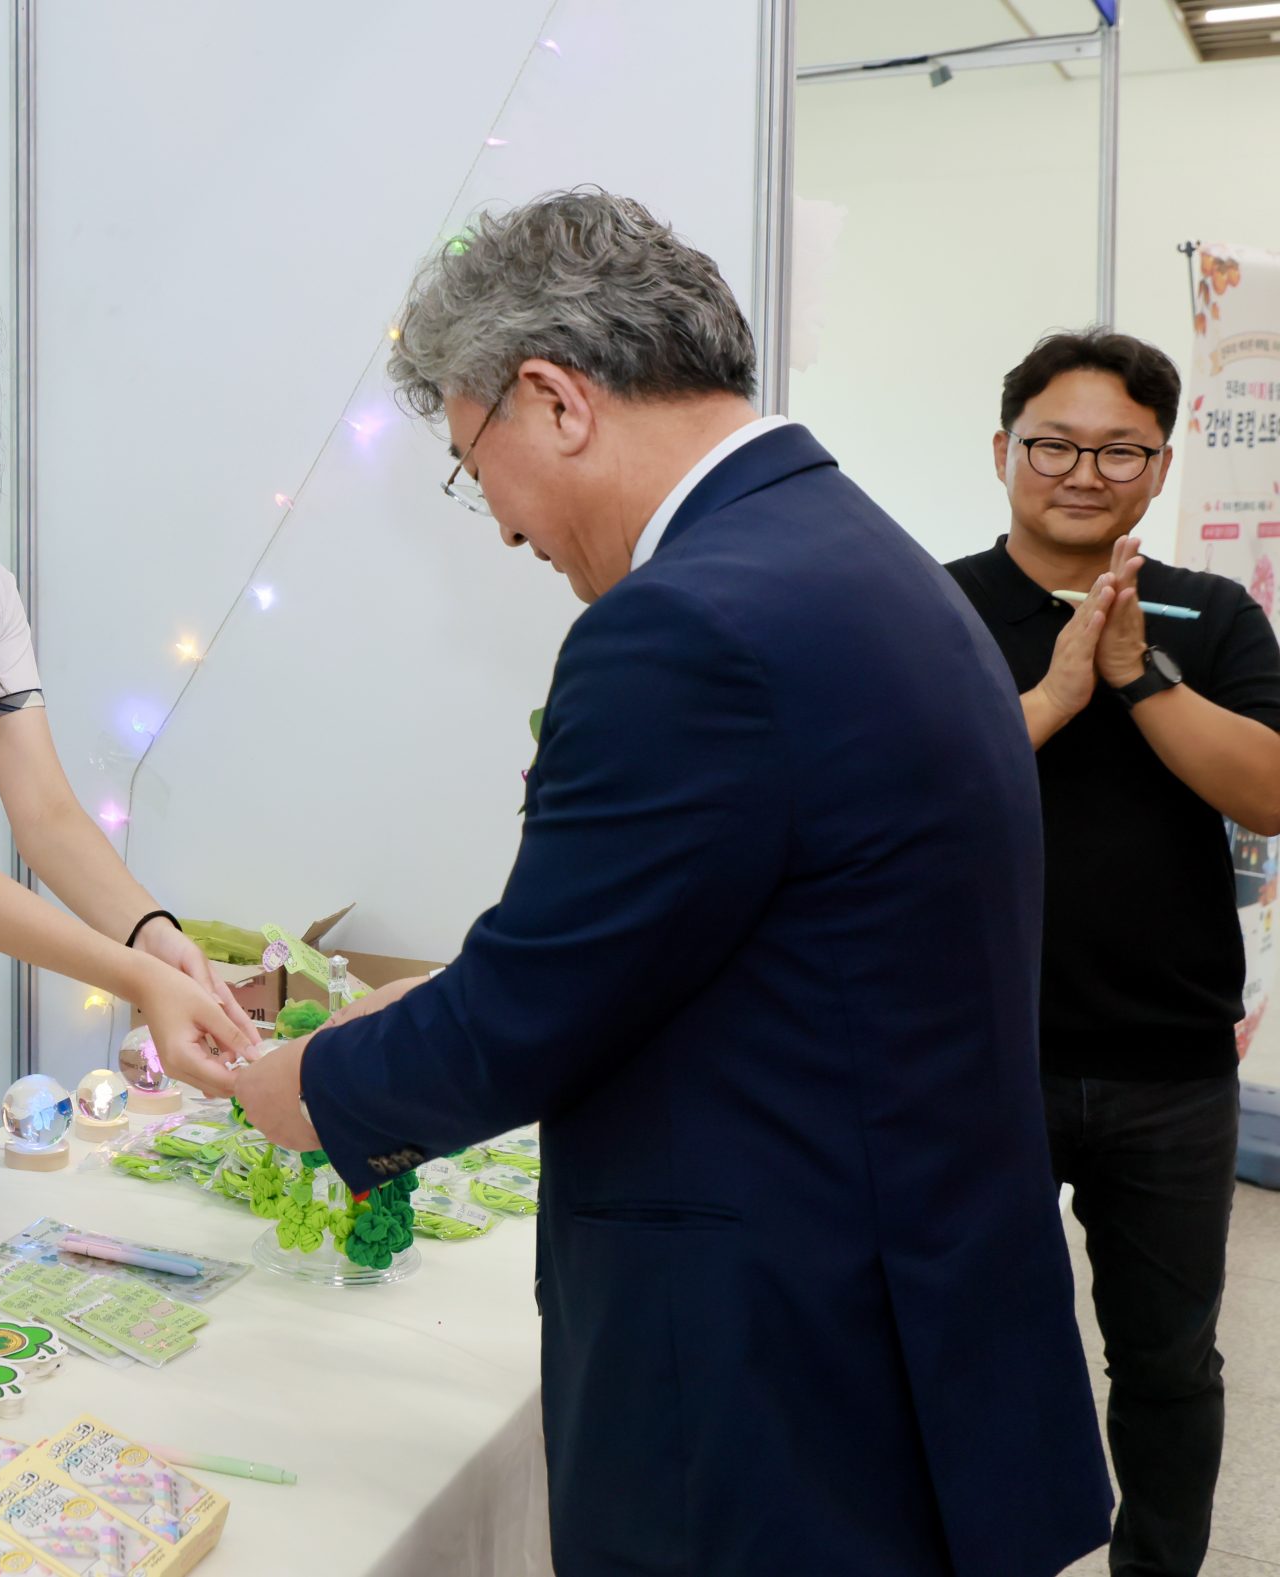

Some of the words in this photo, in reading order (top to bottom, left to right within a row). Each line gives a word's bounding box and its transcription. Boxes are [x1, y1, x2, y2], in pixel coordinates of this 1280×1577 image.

[1206, 409, 1232, 448] 감성
[1235, 410, 1256, 448] 로컬
[1258, 411, 1280, 445] 스토
